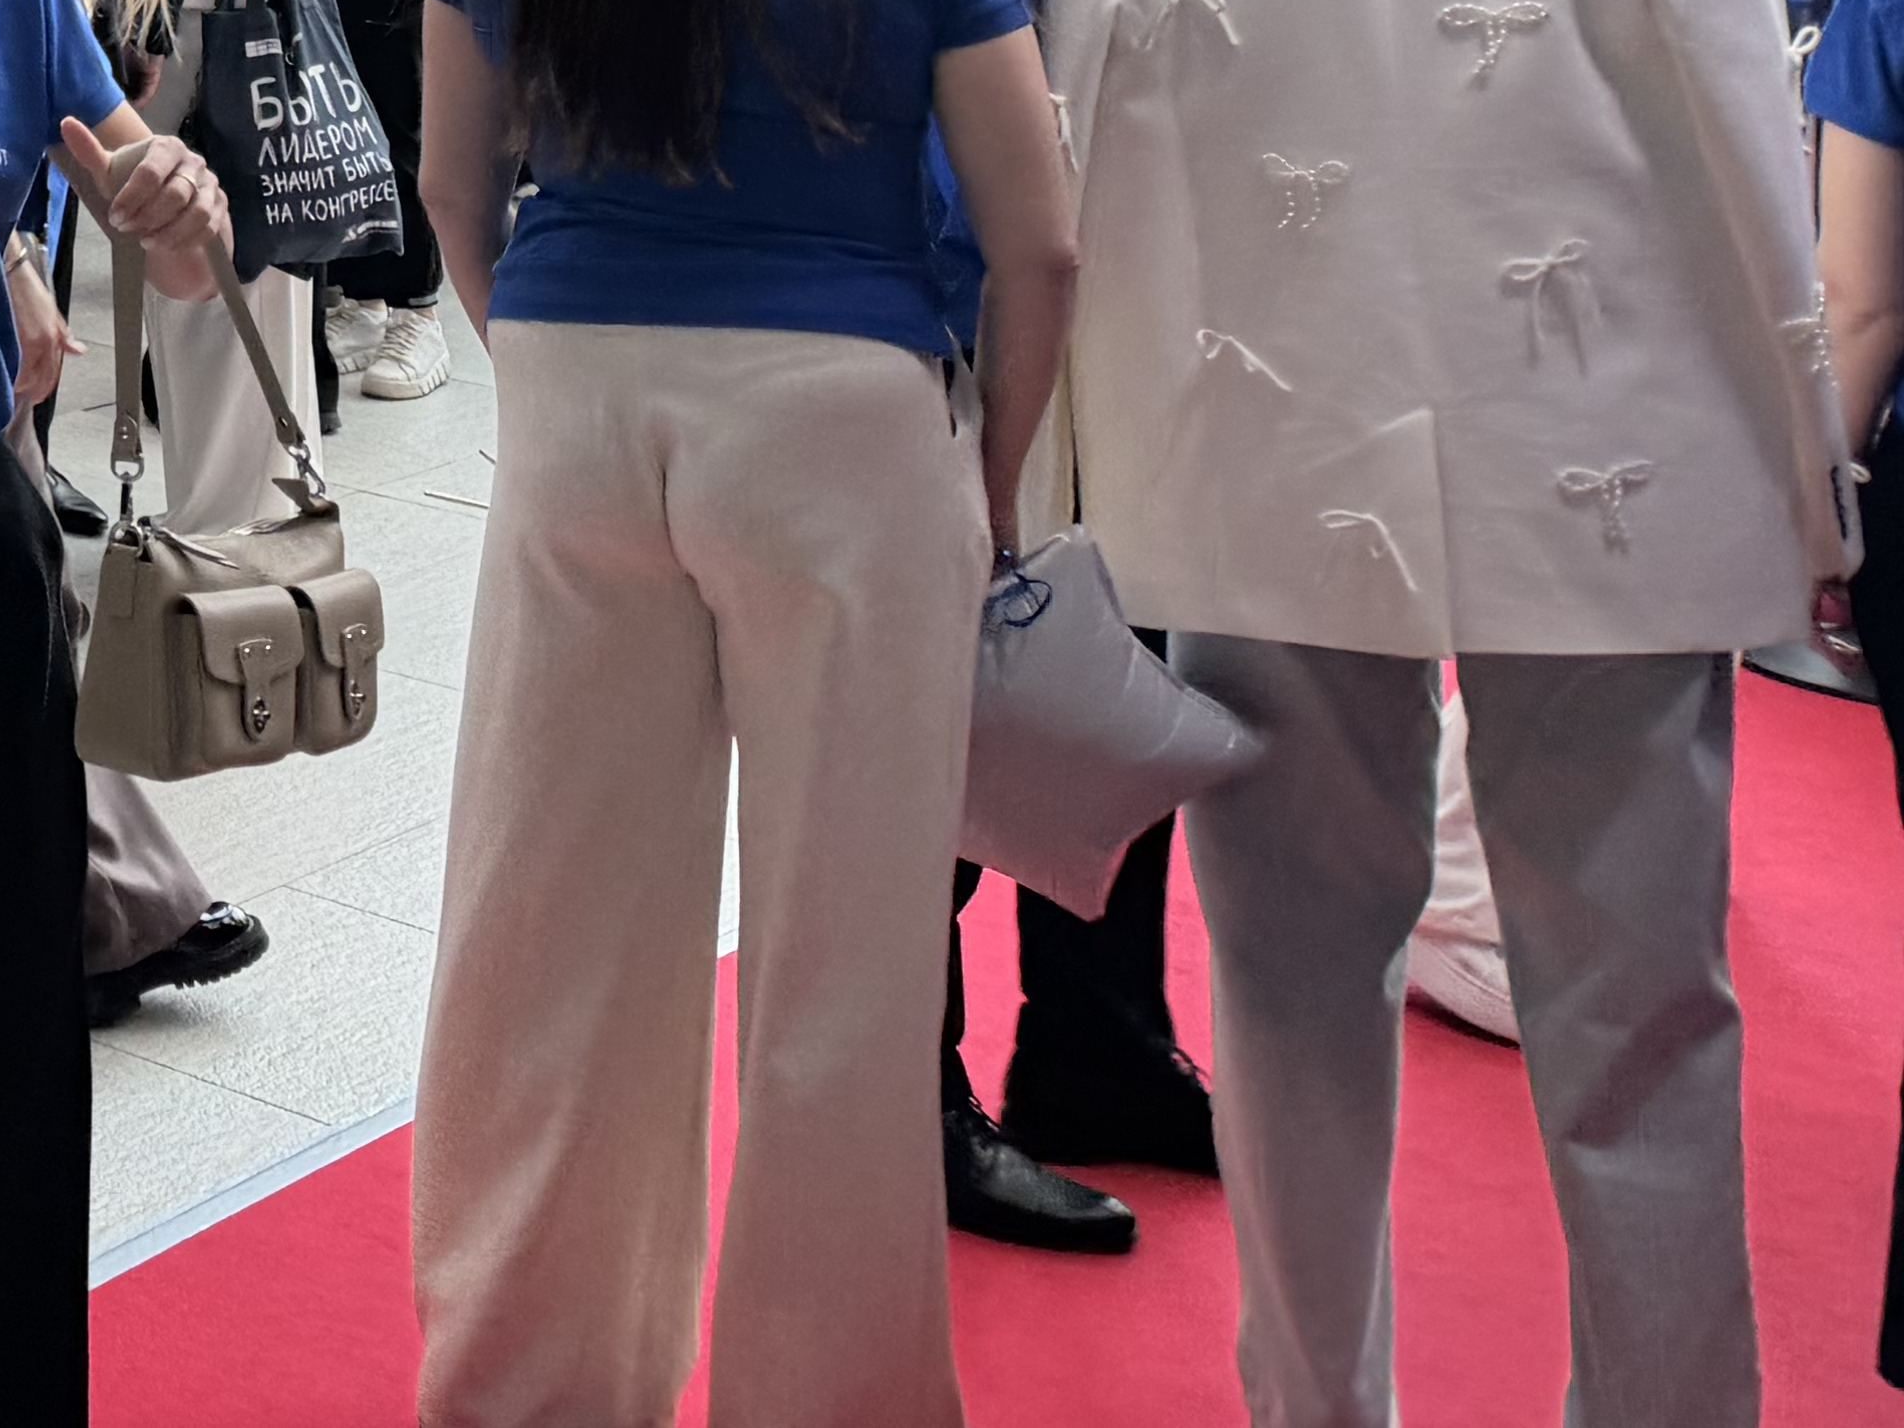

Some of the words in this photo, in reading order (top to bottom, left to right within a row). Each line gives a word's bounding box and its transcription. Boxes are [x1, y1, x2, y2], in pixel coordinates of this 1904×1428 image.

[250, 61, 363, 132] БЫТЬ
[258, 116, 378, 169] ЛИДЕРОМ
[260, 165, 336, 197] ЗНАЧИТ
[342, 150, 393, 183] БЫТЬ
[265, 201, 294, 226] НА
[301, 179, 397, 222] КОНГРЕССЕ
